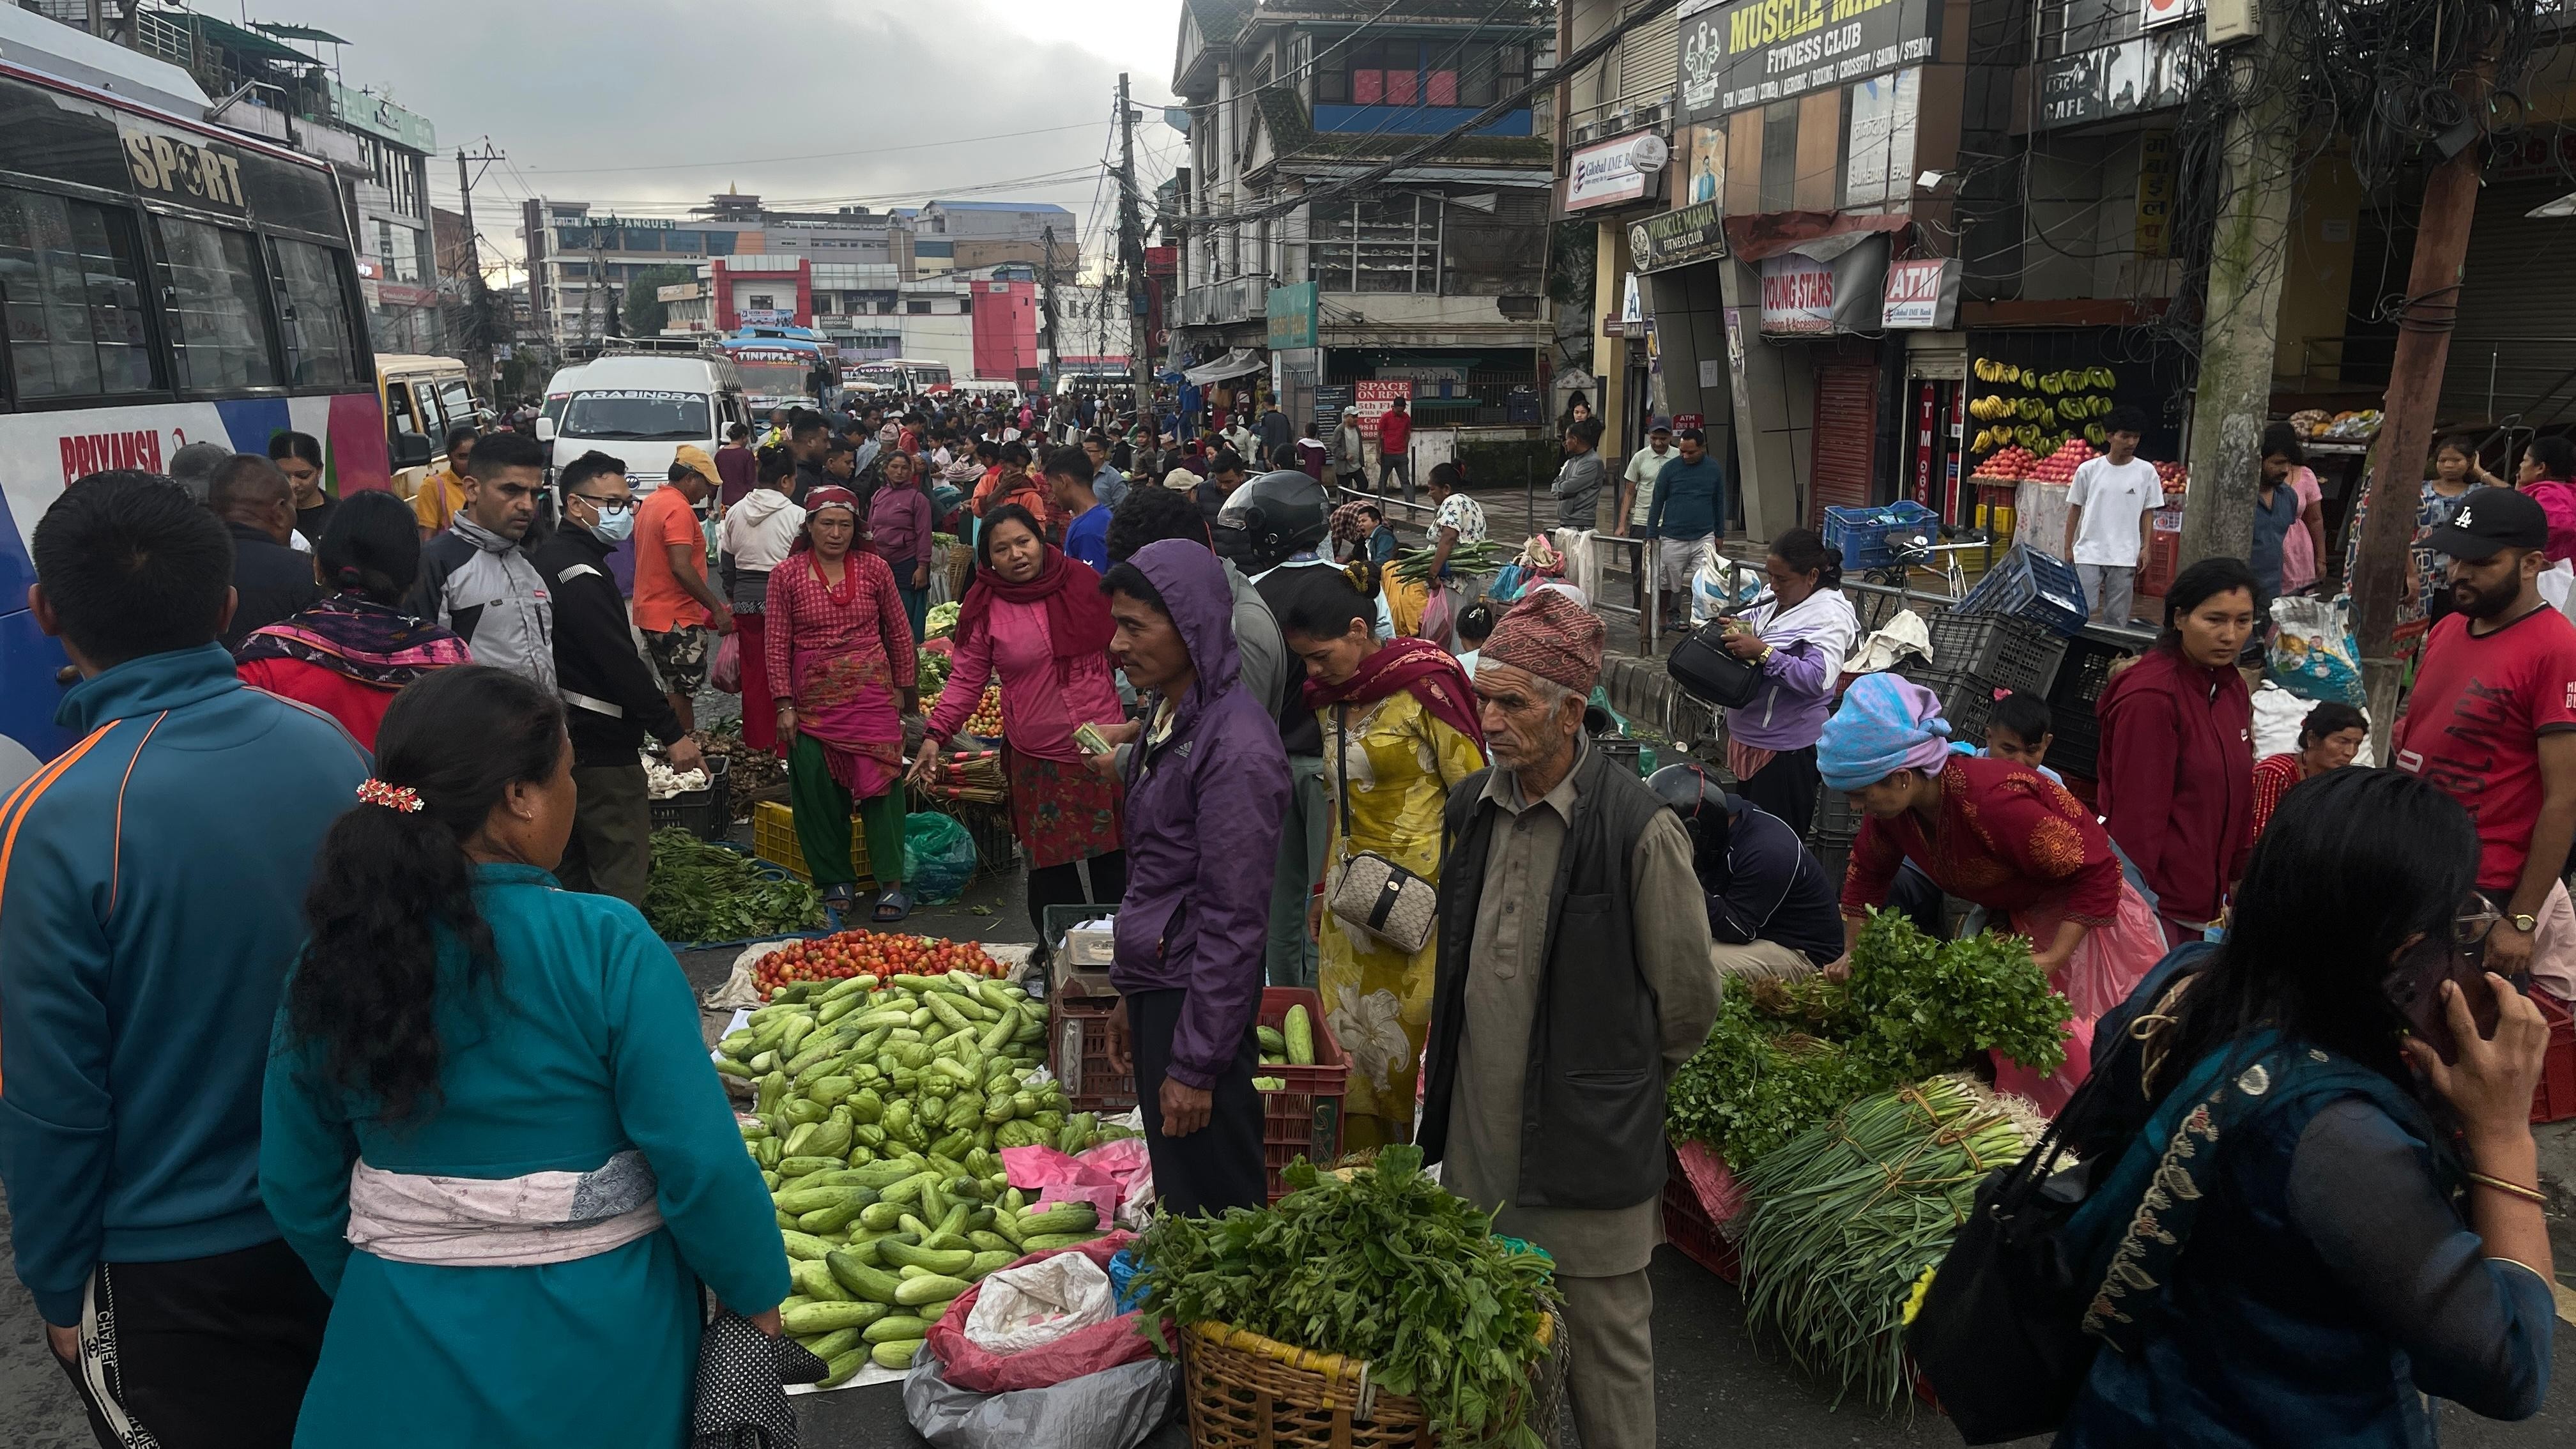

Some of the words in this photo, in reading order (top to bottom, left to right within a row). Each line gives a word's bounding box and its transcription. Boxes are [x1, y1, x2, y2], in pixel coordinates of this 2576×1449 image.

[1729, 0, 1823, 54] MUSCLE
[1767, 34, 1821, 73] FITNESS
[1825, 22, 1862, 57] CLUB
[1812, 64, 1834, 87] BOXING
[1839, 52, 1871, 79] CROSSFIT
[1876, 44, 1897, 68] SAUNA
[1904, 36, 1933, 61] STEAM
[1586, 157, 1607, 176] Global
[1607, 154, 1623, 172] IME
[1648, 213, 1683, 241] MUSCLE
[1683, 204, 1716, 231] MANIA
[1663, 234, 1687, 252] FITNESS
[1687, 230, 1704, 245] CLUB
[1763, 274, 1796, 310] YOUNG
[1798, 271, 1833, 309] STARS
[1889, 266, 1940, 298] ATM
[1920, 308, 1931, 316] Bank
[576, 390, 702, 401] ARABINDRA
[1358, 382, 1408, 390] SPACE
[1358, 390, 1375, 399] ON
[1377, 390, 1410, 399] RENT
[2455, 506, 2472, 528] LA
